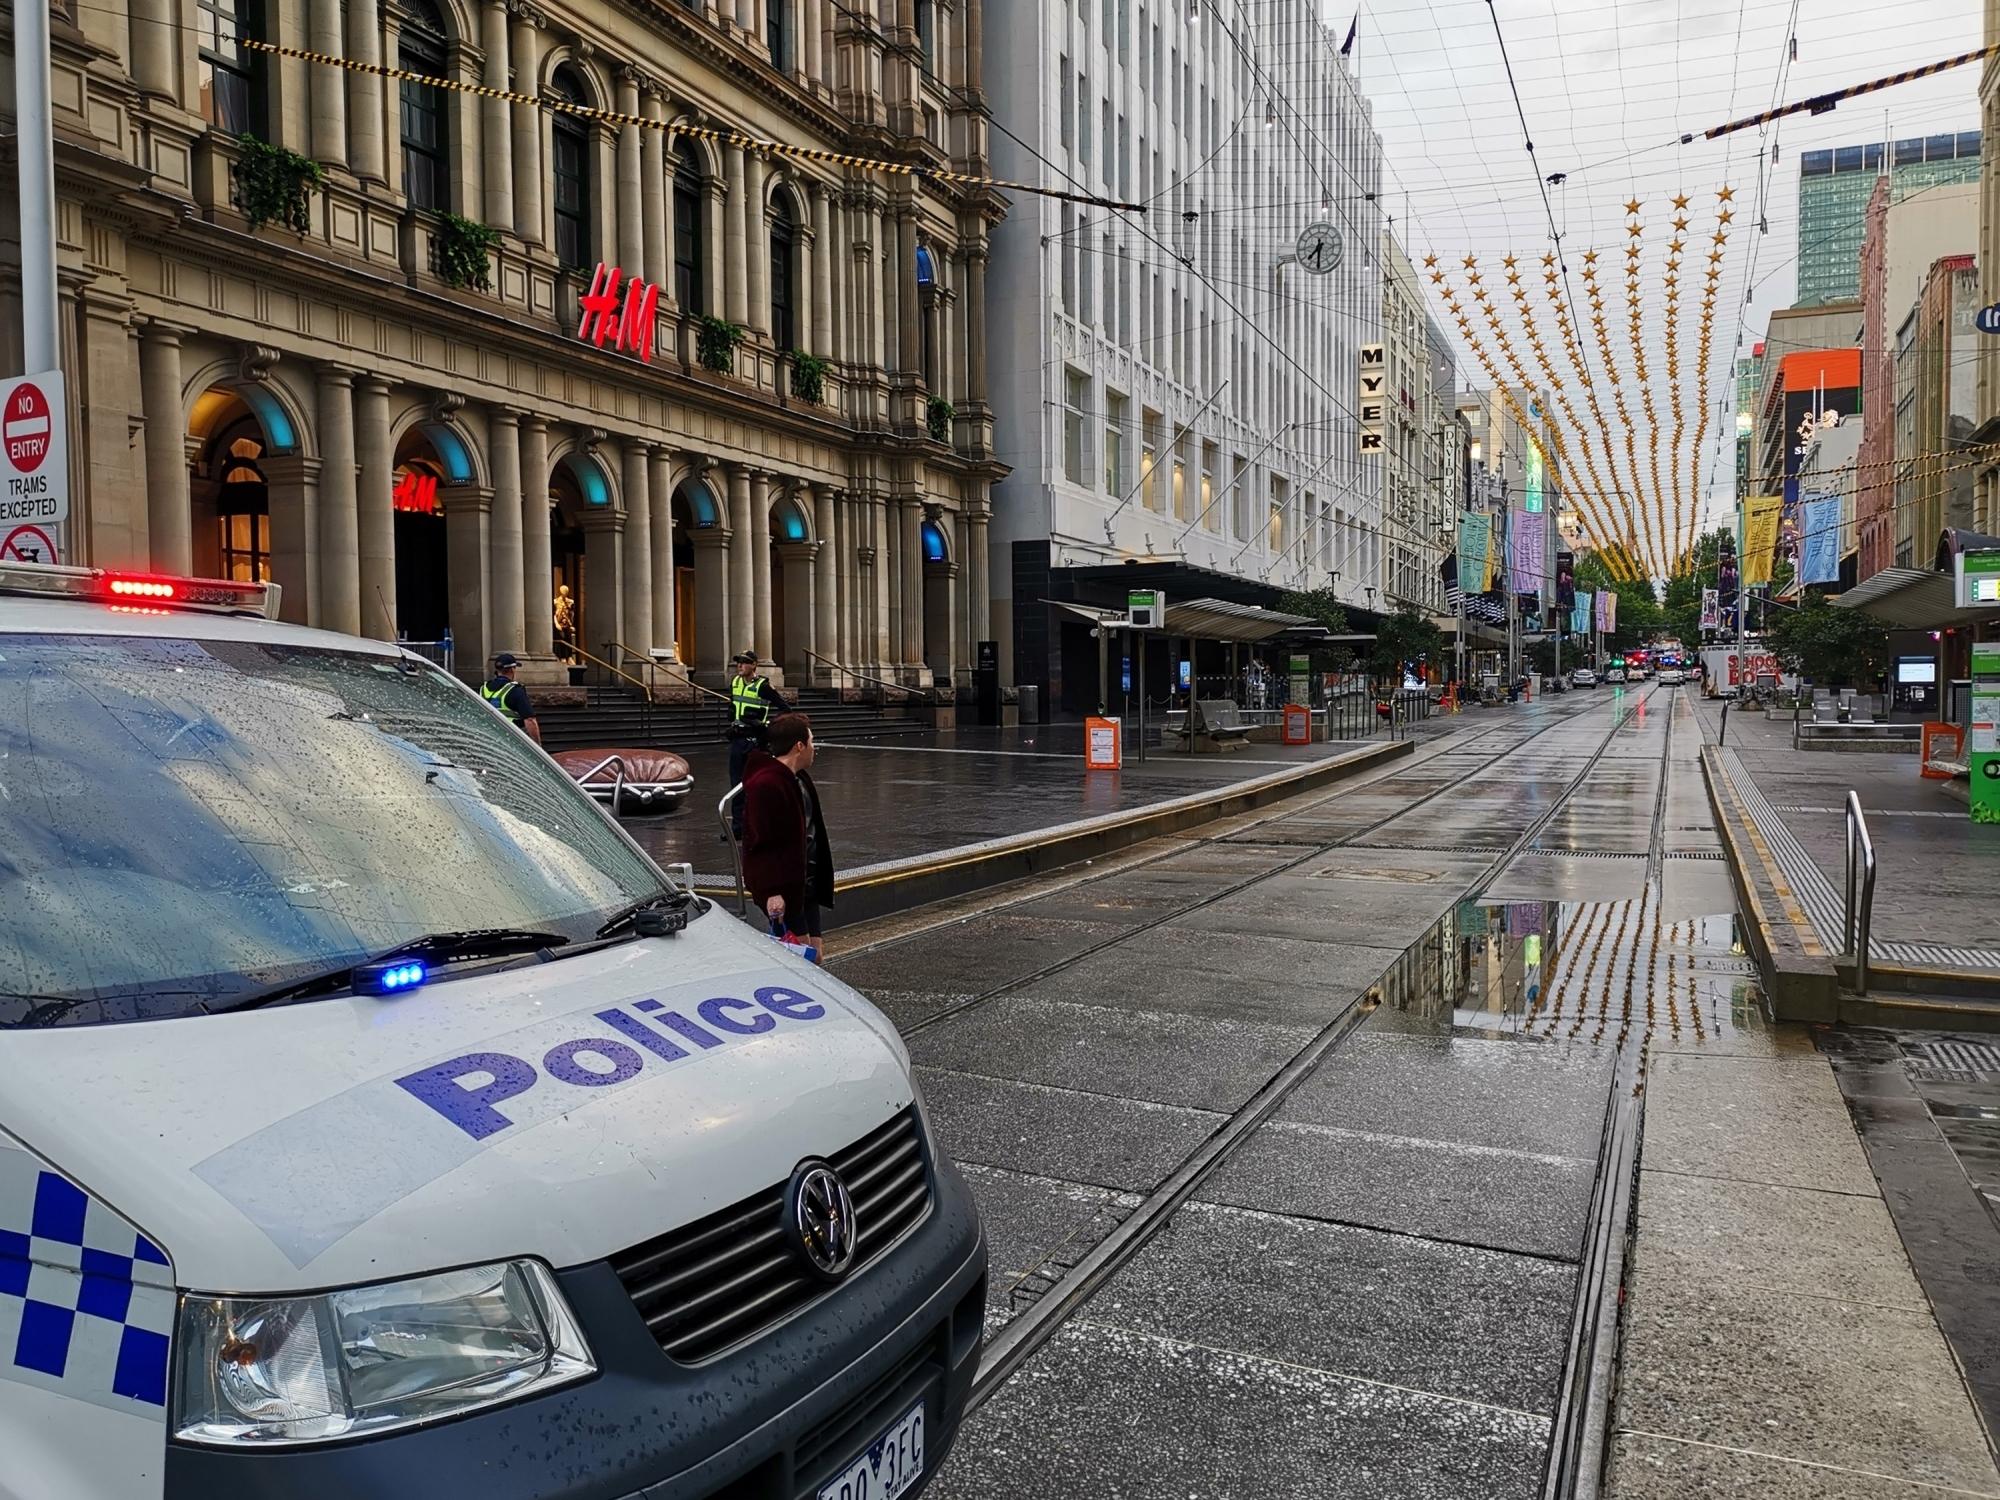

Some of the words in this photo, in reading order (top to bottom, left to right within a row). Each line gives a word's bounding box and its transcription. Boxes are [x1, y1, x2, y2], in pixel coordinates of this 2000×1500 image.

[578, 262, 658, 363] H&M
[18, 395, 33, 414] NO
[1362, 349, 1383, 448] MYER
[11, 438, 45, 460] ENTRY
[1445, 428, 1454, 476] DAVID
[8, 475, 47, 497] TRAMS
[1445, 481, 1453, 526] JONES
[0, 497, 57, 519] EXCEPTED
[1727, 655, 1778, 668] SHOO
[394, 986, 826, 1141] Police
[885, 1416, 921, 1489] 3FC
[886, 1479, 902, 1500] STAY
[902, 1461, 919, 1486] ALIVE
